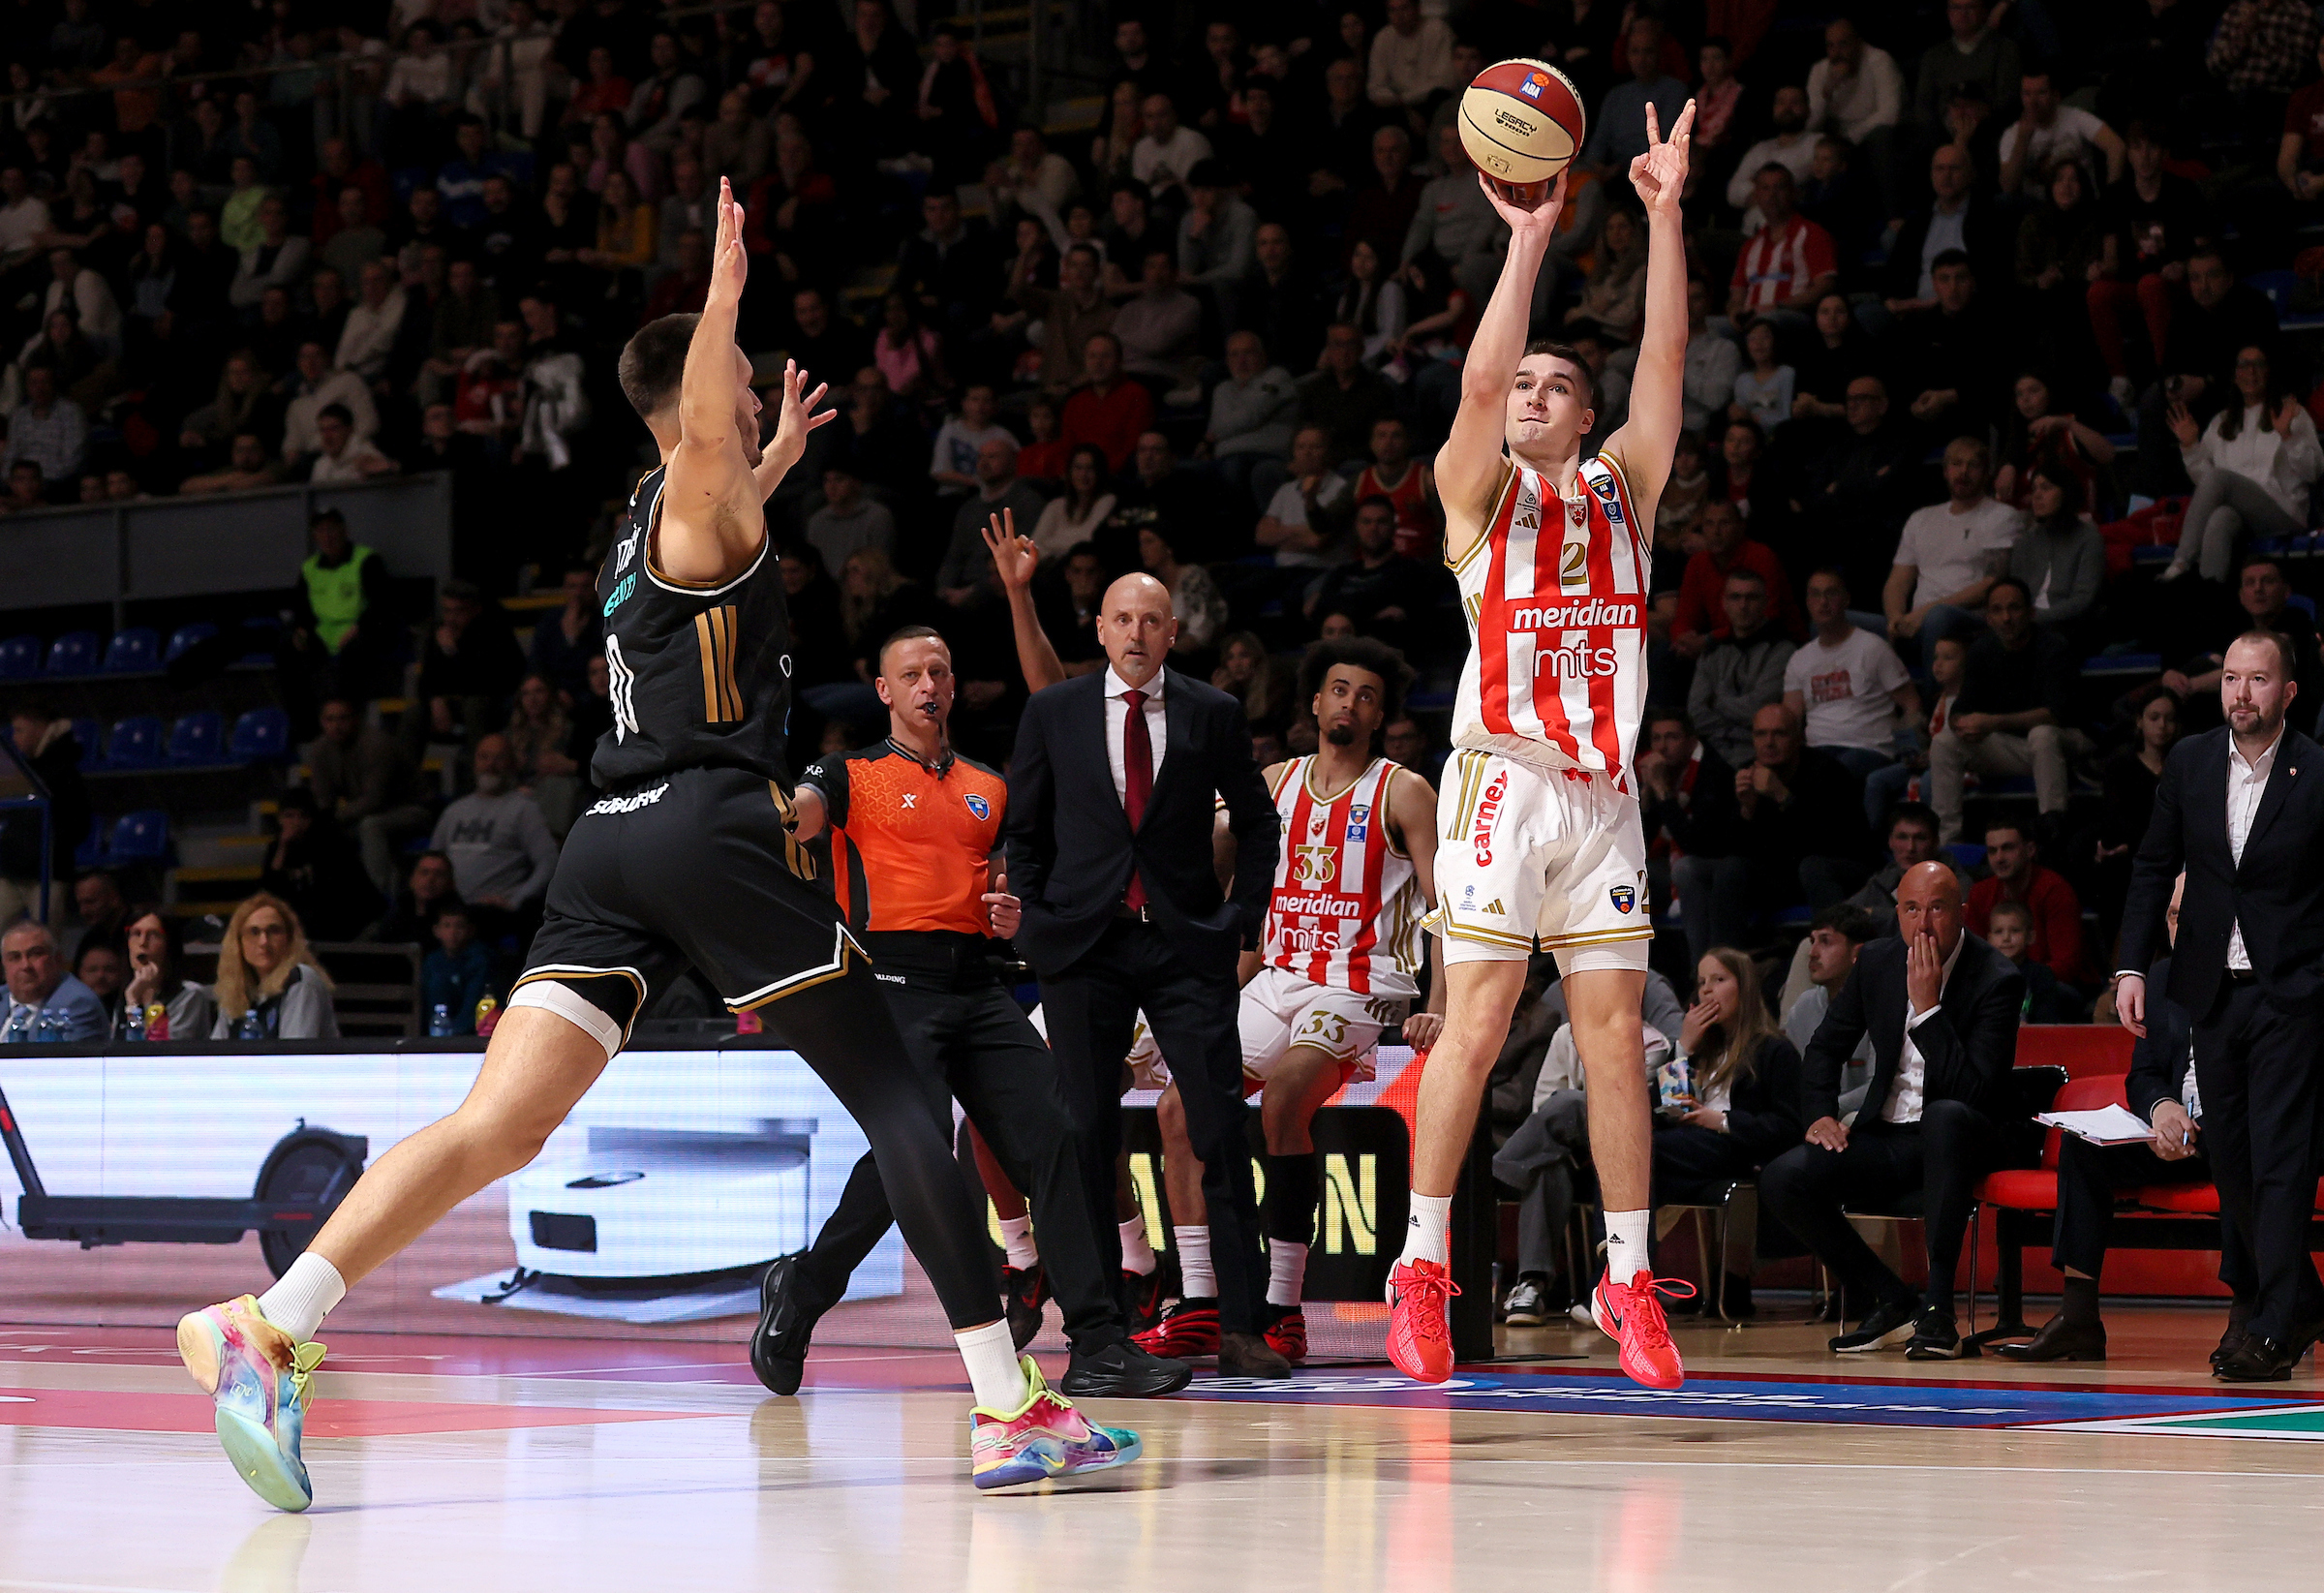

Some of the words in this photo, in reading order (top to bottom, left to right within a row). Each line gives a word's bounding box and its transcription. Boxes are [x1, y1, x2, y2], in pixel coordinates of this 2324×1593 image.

[1521, 81, 1541, 99] ABA
[1494, 108, 1538, 134] LEGACY
[1561, 541, 1588, 586] 2
[1514, 598, 1637, 630] meridian
[1534, 640, 1618, 679] mts
[452, 817, 496, 842] HH
[1293, 844, 1337, 883] 33
[1275, 893, 1360, 917] meridian
[1279, 925, 1340, 952] mts
[1300, 1010, 1351, 1044] 33
